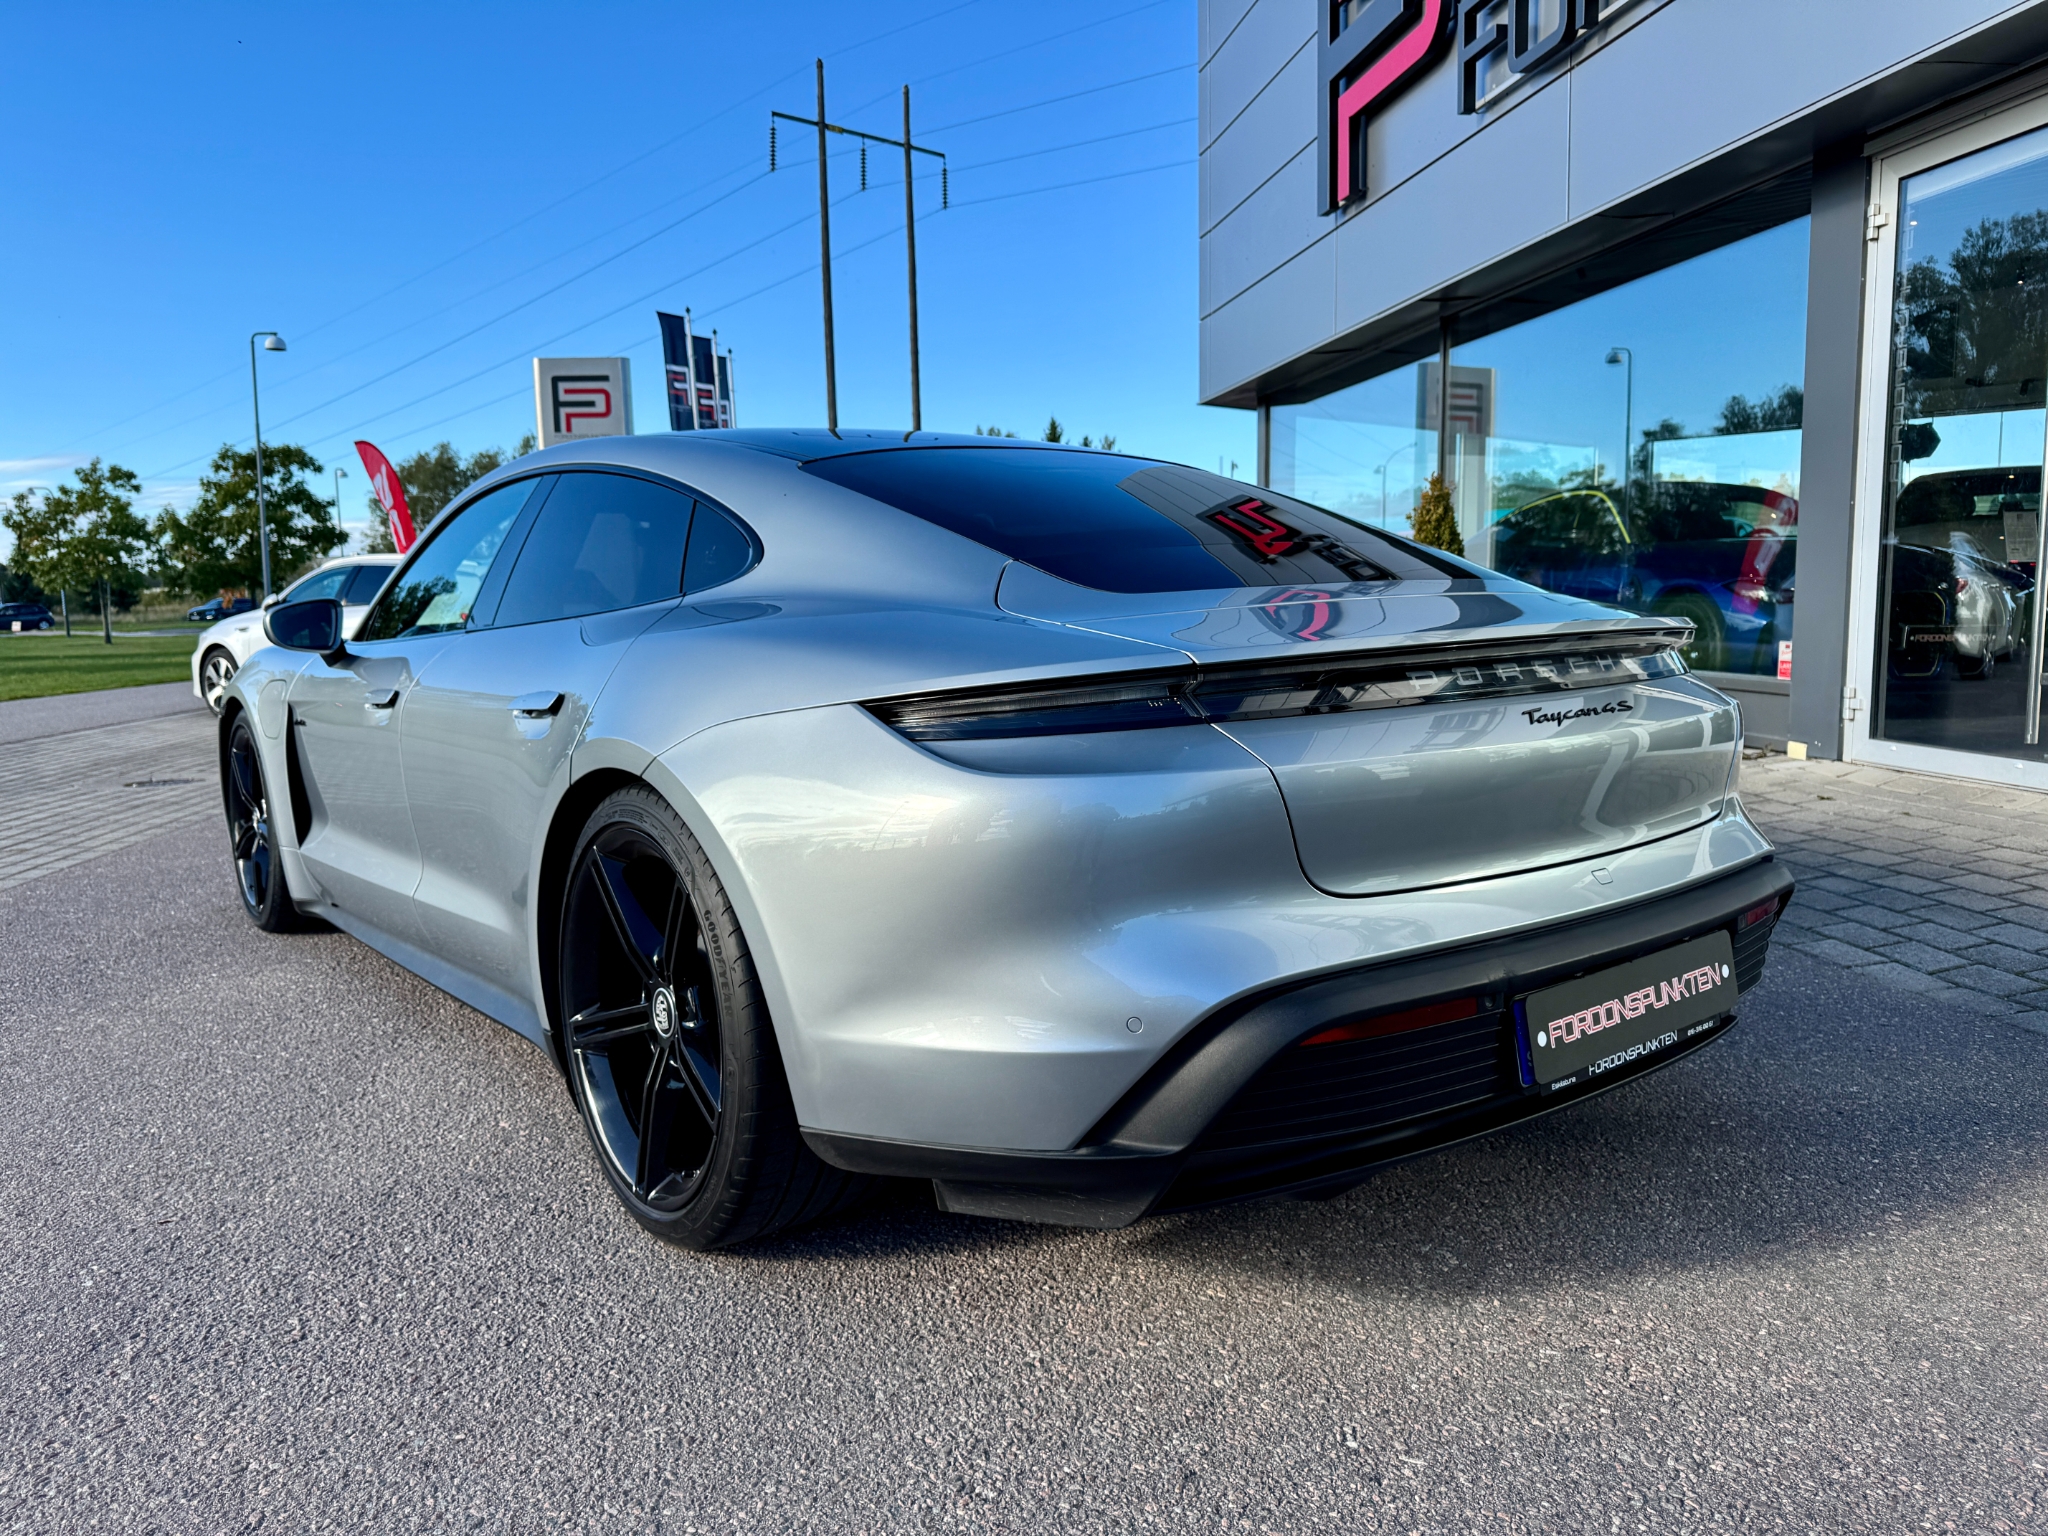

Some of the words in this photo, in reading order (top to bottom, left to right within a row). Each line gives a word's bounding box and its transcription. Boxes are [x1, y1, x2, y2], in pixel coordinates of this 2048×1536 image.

[1521, 706, 1601, 727] Taycan
[703, 909, 733, 1018] GOODYEAR
[1548, 962, 1722, 1049] FORDONSPUNKTEN
[1588, 1029, 1678, 1076] FORDONSPUNKTEN
